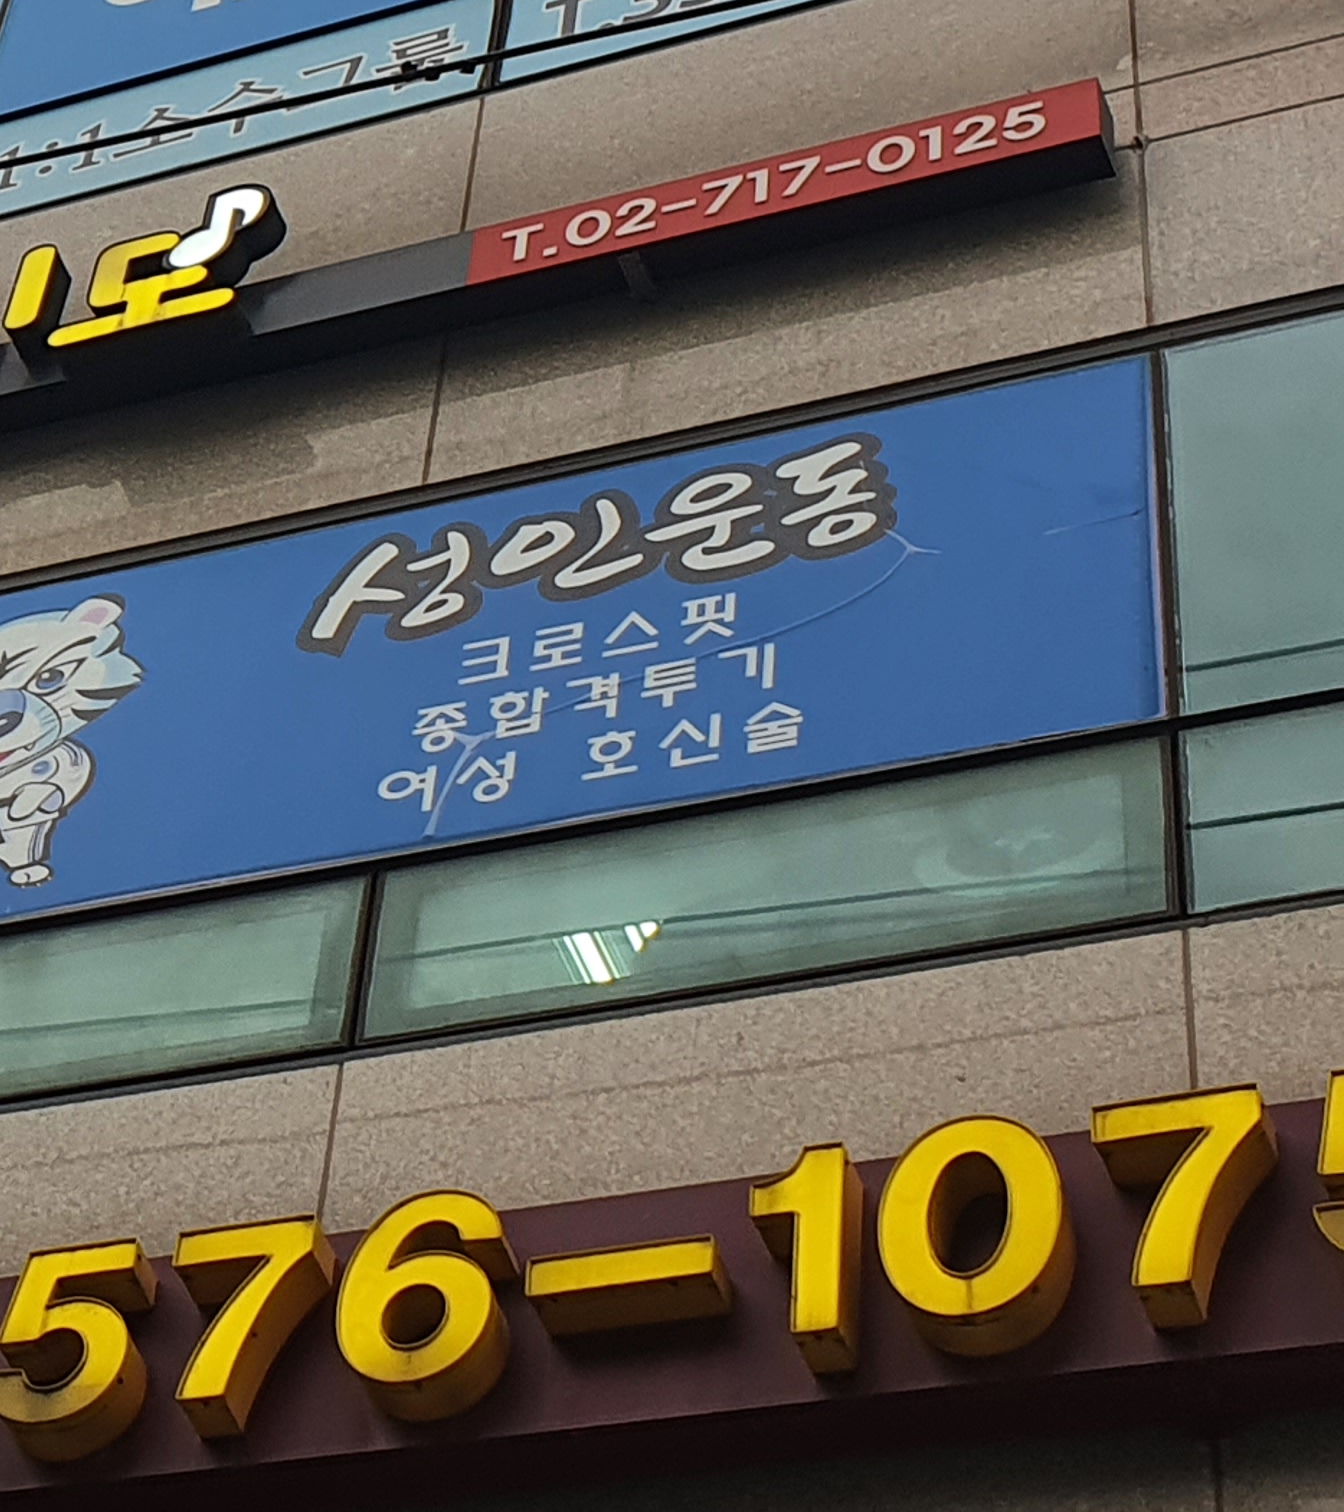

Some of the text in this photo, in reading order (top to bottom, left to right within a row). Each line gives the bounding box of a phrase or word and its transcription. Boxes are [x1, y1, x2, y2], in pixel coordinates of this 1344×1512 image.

[501, 99, 1047, 263] T.02-717-0125
[307, 438, 890, 648] 성인운동
[457, 593, 740, 688] 크로스핏
[411, 645, 780, 756] 종합격투기
[376, 702, 807, 812] 여성 호신술
